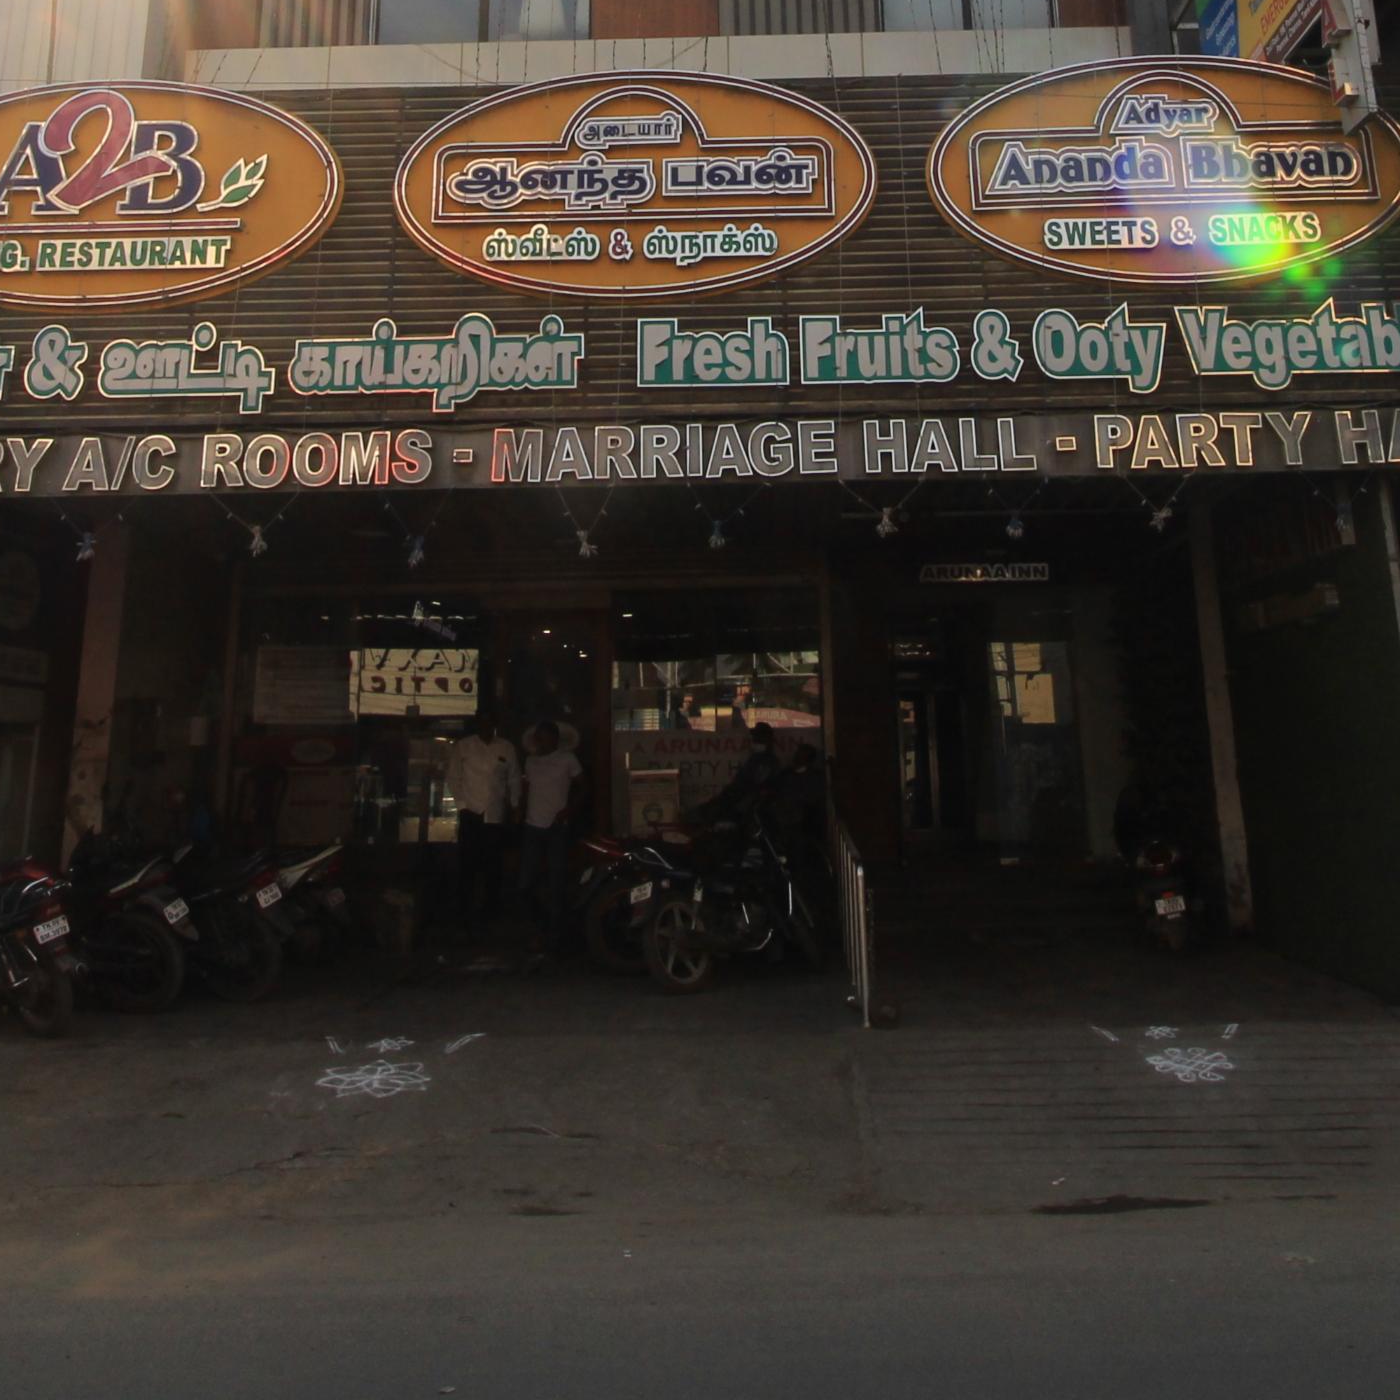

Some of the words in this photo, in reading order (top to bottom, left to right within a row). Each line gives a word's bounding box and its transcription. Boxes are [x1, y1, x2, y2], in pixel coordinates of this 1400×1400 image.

[575, 112, 682, 149] அடையார்
[1115, 97, 1215, 133] Adyar
[447, 152, 655, 209] ஆனந்த
[662, 148, 817, 196] பவன்
[991, 140, 1169, 190] Ananda
[1185, 138, 1358, 186] Bhavan
[484, 224, 600, 261] ஸ்வீட்ஸ்
[609, 231, 633, 259] &
[1044, 218, 1159, 250] SWEETS
[1170, 216, 1195, 245] &
[1208, 212, 1320, 246] SNACKS
[36, 237, 231, 271] RESTAURANT
[25, 325, 88, 399] &
[98, 321, 274, 414] ஊட்டி
[289, 313, 584, 412] காய்கறிகள்
[637, 318, 789, 386] Fresh
[800, 307, 960, 384] Fruits
[971, 309, 1023, 381] &
[1033, 302, 1165, 393] Ooty
[62, 434, 178, 492] A/C
[201, 429, 431, 489] ROOMS
[491, 420, 837, 482] MARRIAGE
[863, 418, 1037, 473] HALL
[1094, 412, 1311, 469] PARTY
